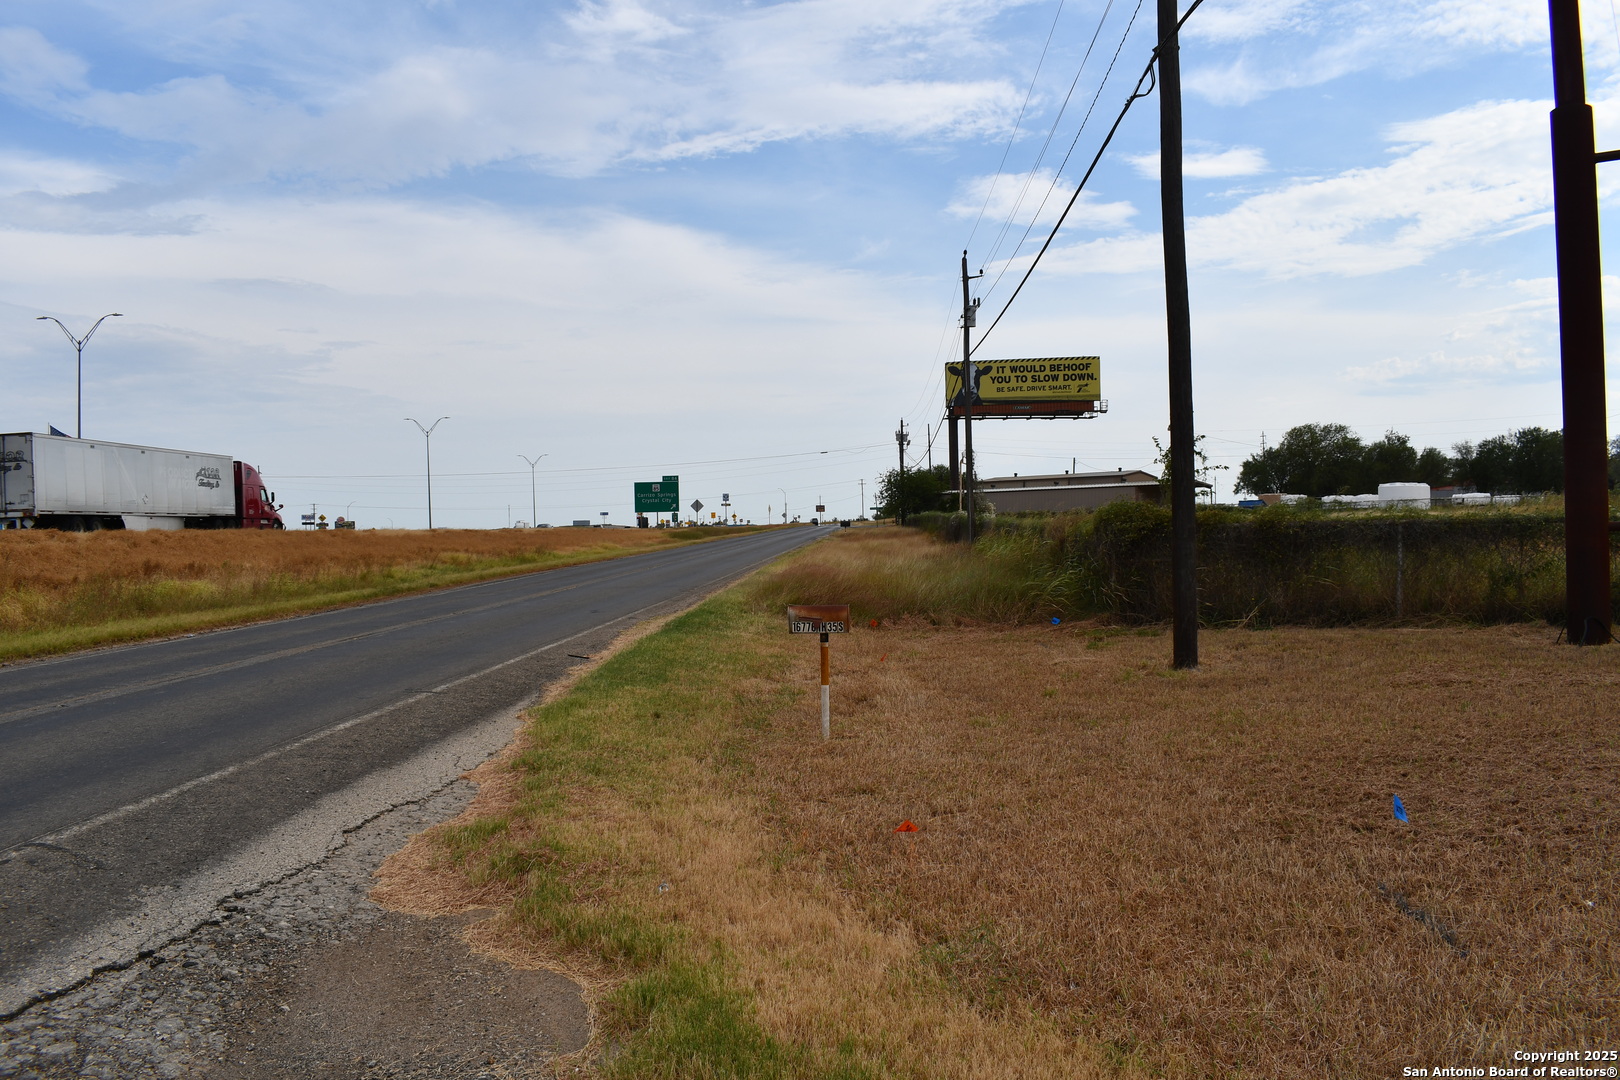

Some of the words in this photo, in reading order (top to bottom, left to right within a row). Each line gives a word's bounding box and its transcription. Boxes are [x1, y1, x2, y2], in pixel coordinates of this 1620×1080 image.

[996, 365, 1006, 374] IT
[1009, 365, 1046, 373] WOULD
[1049, 363, 1091, 372] BEHOOF
[990, 375, 1011, 384] YOU
[1014, 375, 1028, 383] TO
[1031, 374, 1059, 383] SLOW
[1063, 372, 1097, 381] DOWN.
[827, 622, 837, 632] 35
[838, 622, 844, 632] S
